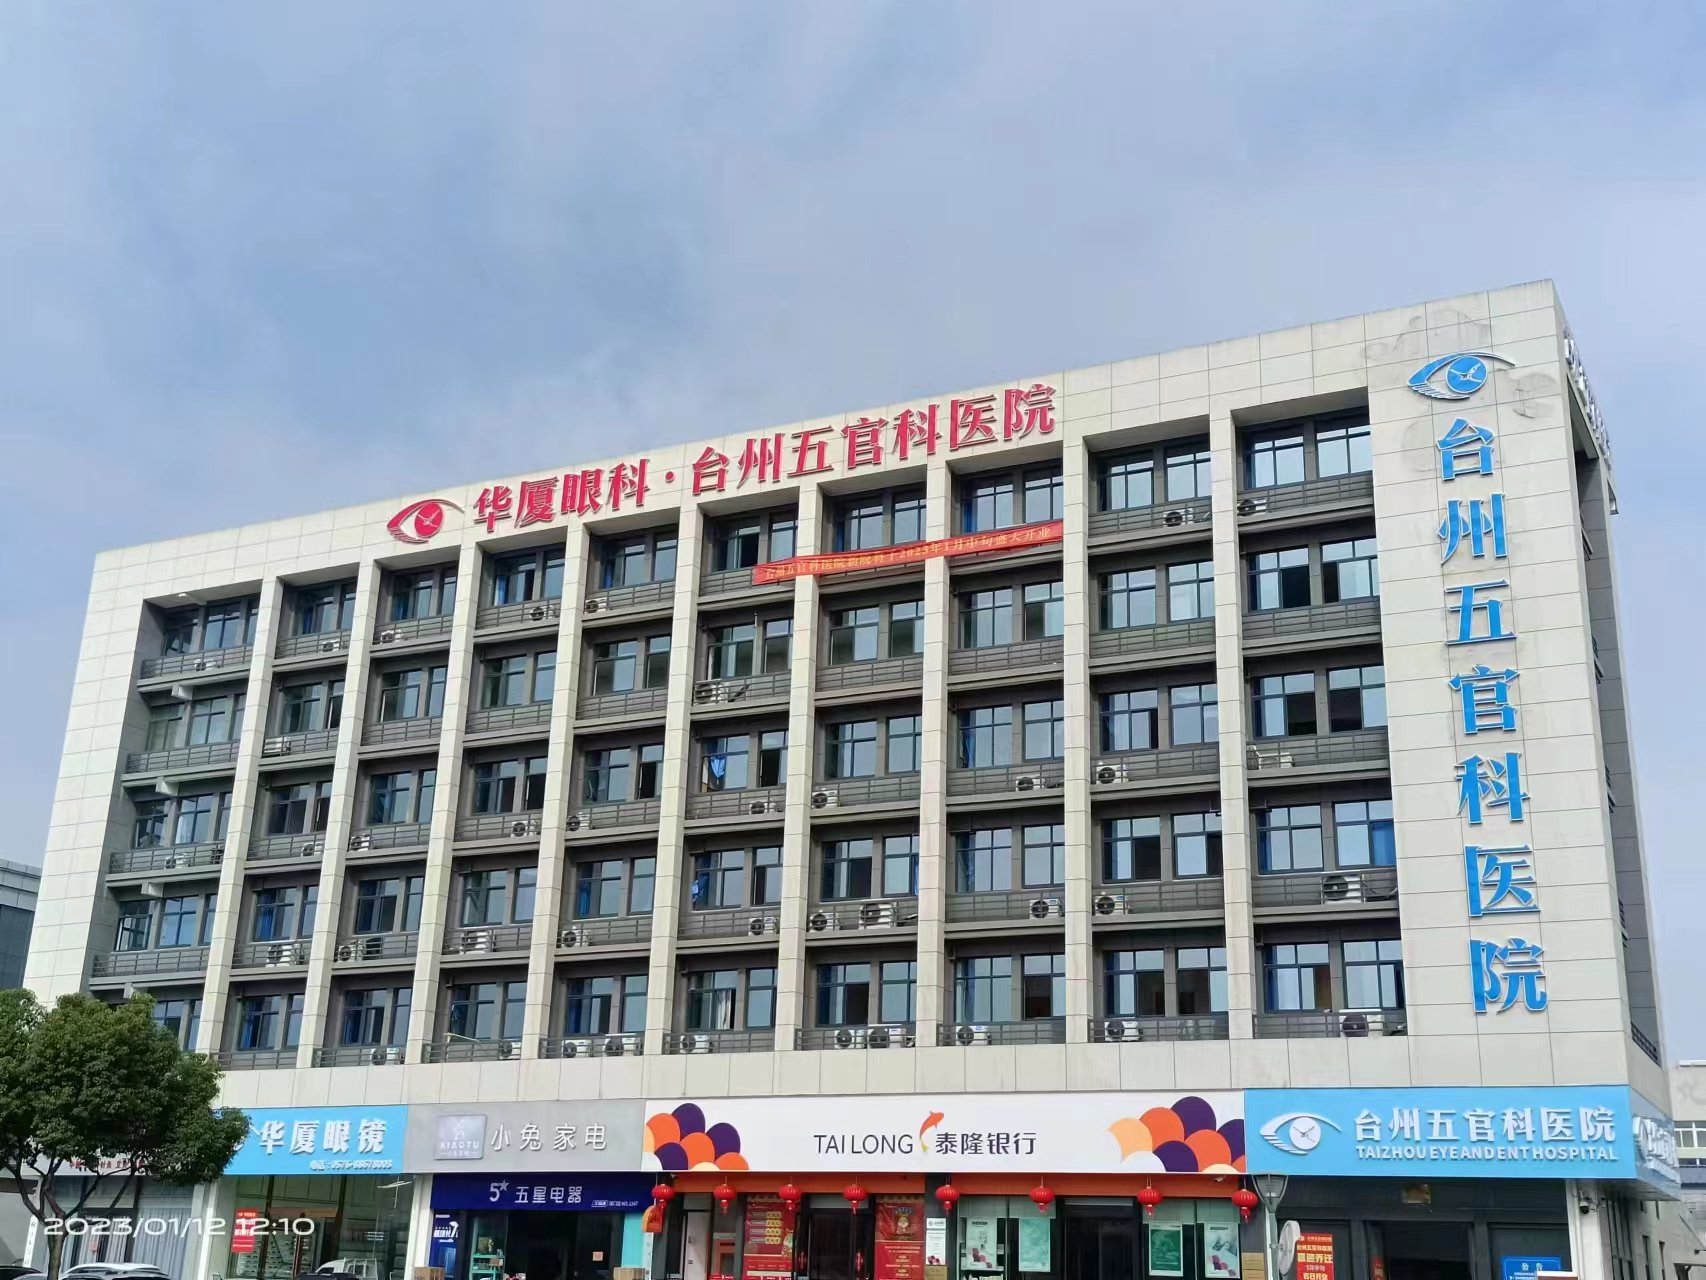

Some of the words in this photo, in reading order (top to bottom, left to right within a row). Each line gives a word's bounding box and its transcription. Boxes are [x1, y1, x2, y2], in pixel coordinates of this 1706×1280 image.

[1436, 417, 1548, 1014] 台州五官科医院
[260, 1119, 388, 1155] 华厦眼镜
[491, 1122, 607, 1151] 小兔家电
[1354, 1106, 1616, 1142] 台州五官科医院
[936, 1132, 1037, 1155] 泰隆银行
[514, 1186, 583, 1204] 五星电器
